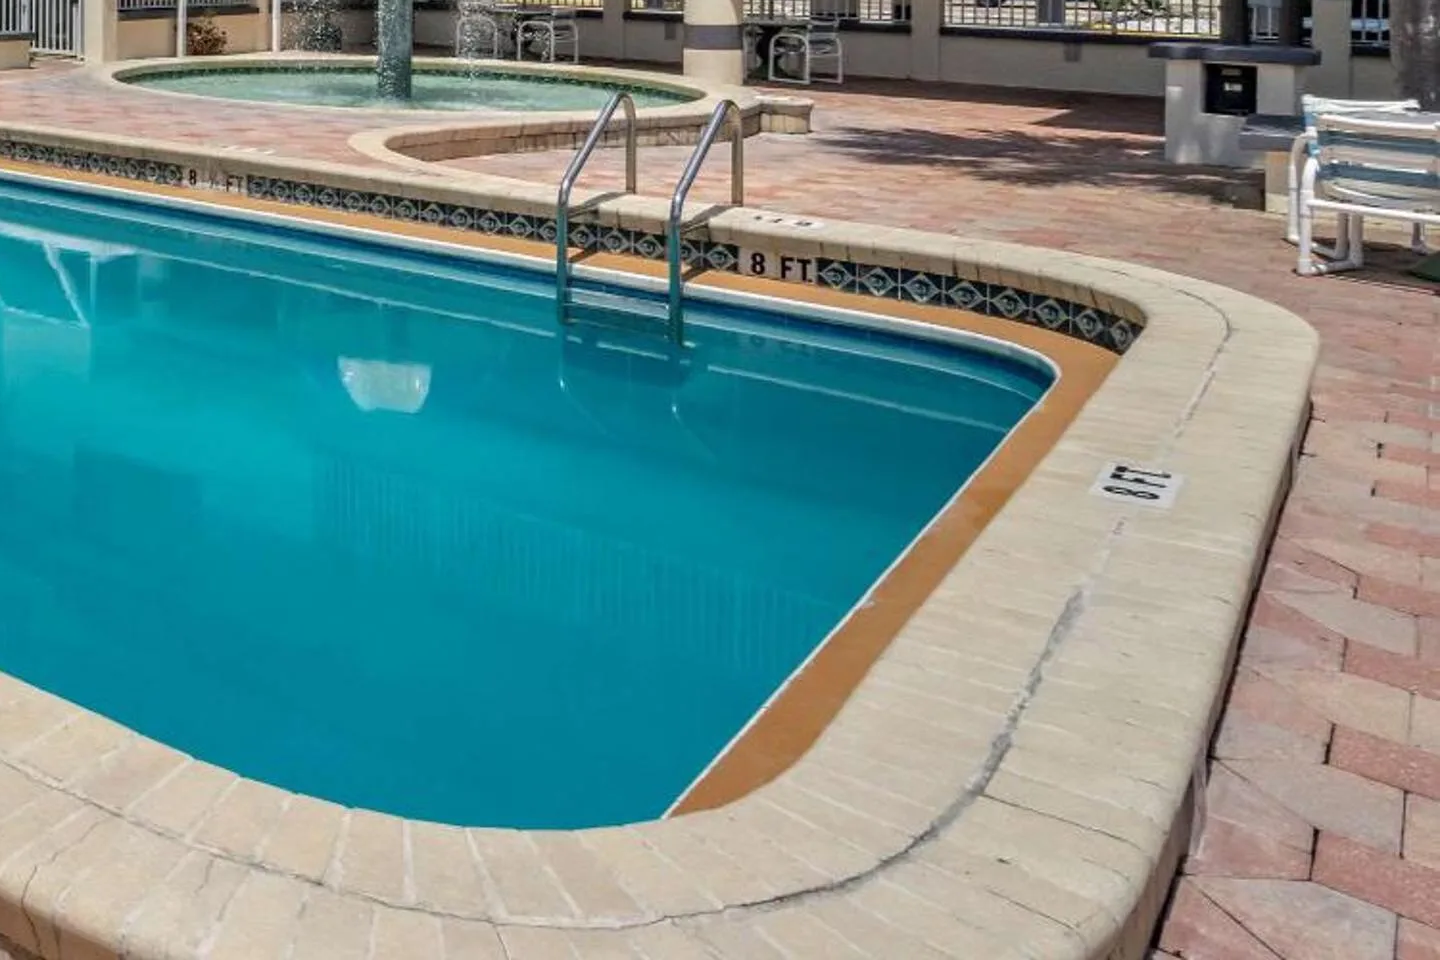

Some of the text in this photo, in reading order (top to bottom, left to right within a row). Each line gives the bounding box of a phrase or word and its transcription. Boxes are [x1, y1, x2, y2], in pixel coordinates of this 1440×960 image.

[189, 168, 197, 186] 8
[750, 252, 766, 275] 8
[1102, 485, 1160, 500] 8
